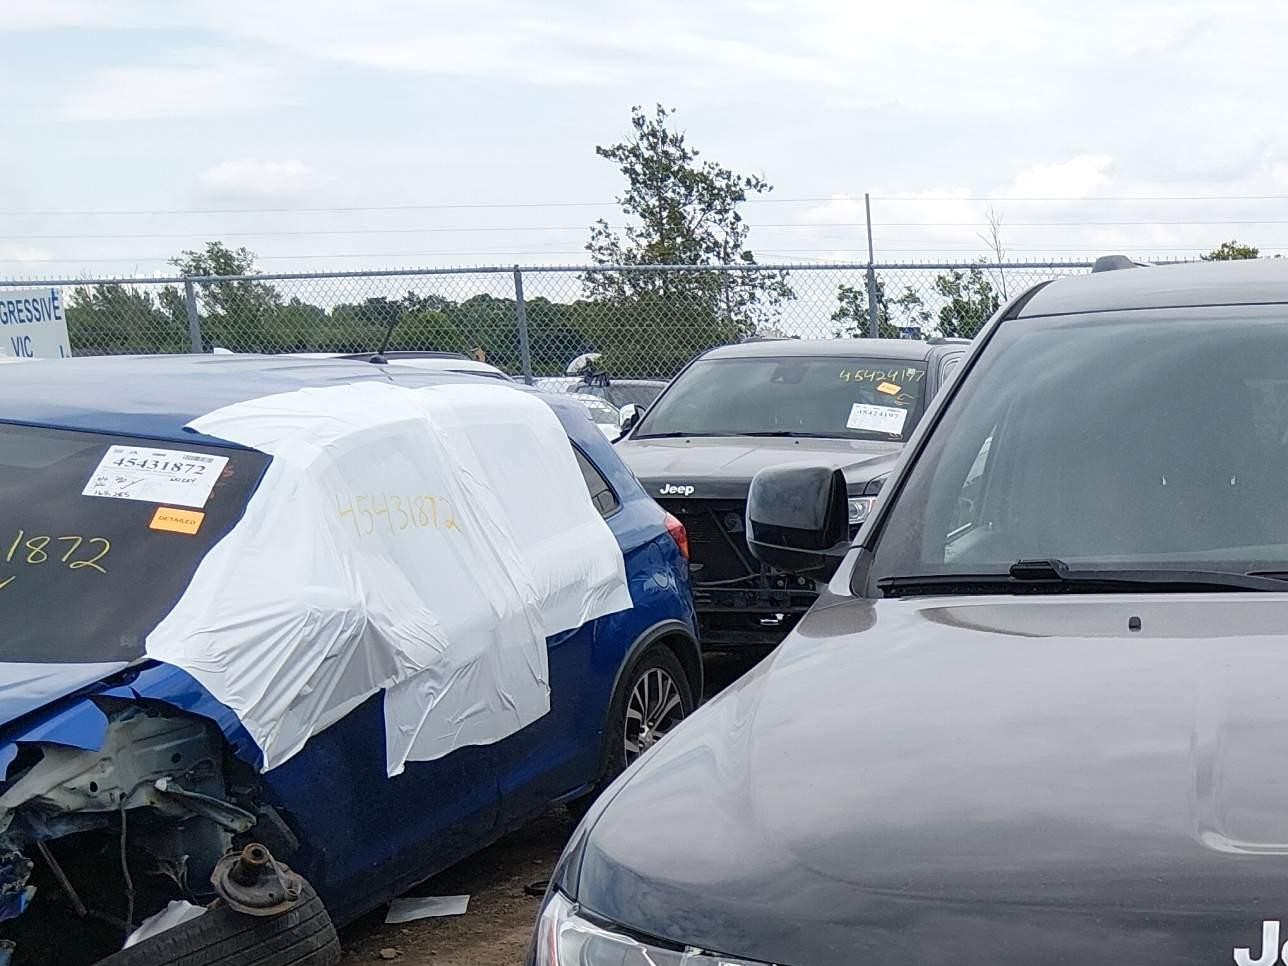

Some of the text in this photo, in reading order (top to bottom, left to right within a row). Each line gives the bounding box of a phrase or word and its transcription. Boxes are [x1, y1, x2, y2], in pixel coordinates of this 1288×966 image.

[112, 457, 207, 475] 45431872
[659, 483, 695, 497] Jeep
[158, 514, 197, 526] DETAILED
[335, 494, 464, 537] 45431872
[6, 529, 111, 574] 1872
